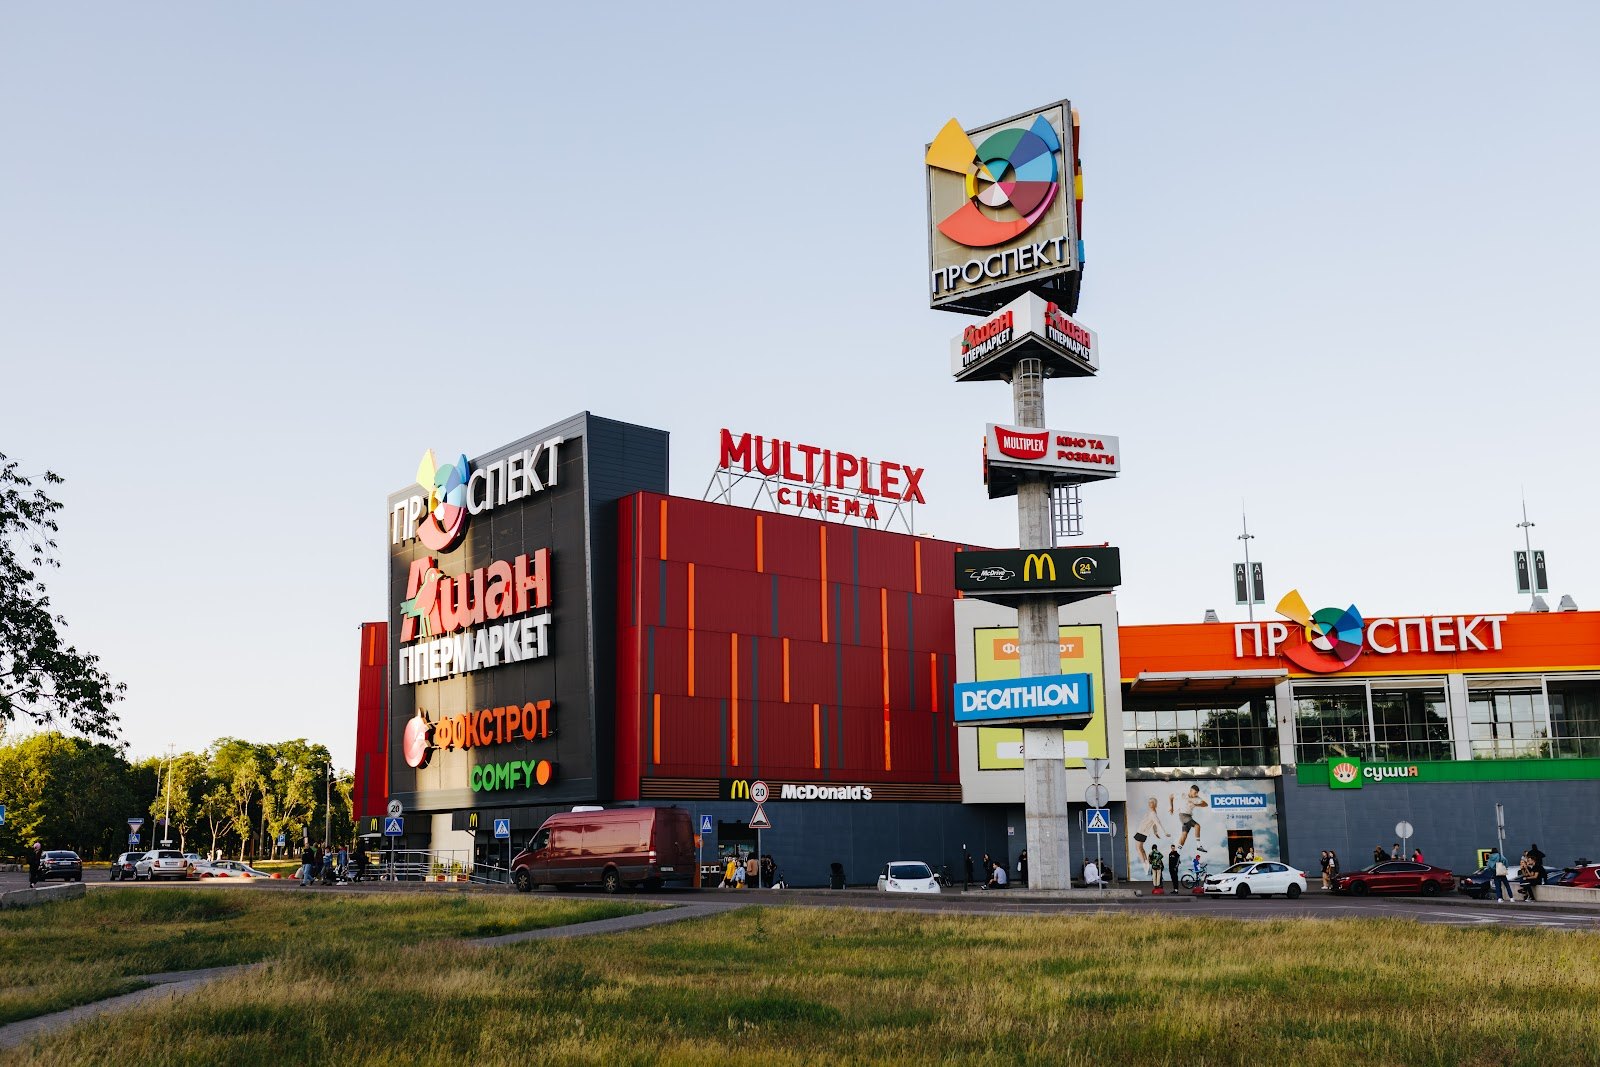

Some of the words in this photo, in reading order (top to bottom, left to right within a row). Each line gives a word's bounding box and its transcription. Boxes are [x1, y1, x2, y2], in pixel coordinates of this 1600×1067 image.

[932, 236, 1068, 293] ПРОСПЕКТ
[1003, 436, 1044, 452] MULTIPLEX
[1056, 436, 1086, 448] КІНО
[1088, 440, 1104, 450] ТА
[1057, 450, 1114, 464] РОЗВАГИ
[720, 428, 926, 504] MULTIPLEX
[777, 488, 879, 520] CINEMA
[399, 613, 551, 685] ГІПЕРМАРКЕТ
[962, 683, 1079, 712] DECATHLON
[435, 699, 551, 750] ФОКСТРОТ
[470, 759, 536, 792] COMFY
[755, 788, 765, 797] 20
[781, 784, 872, 800] McDonald's
[1213, 797, 1263, 805] DECATHLON
